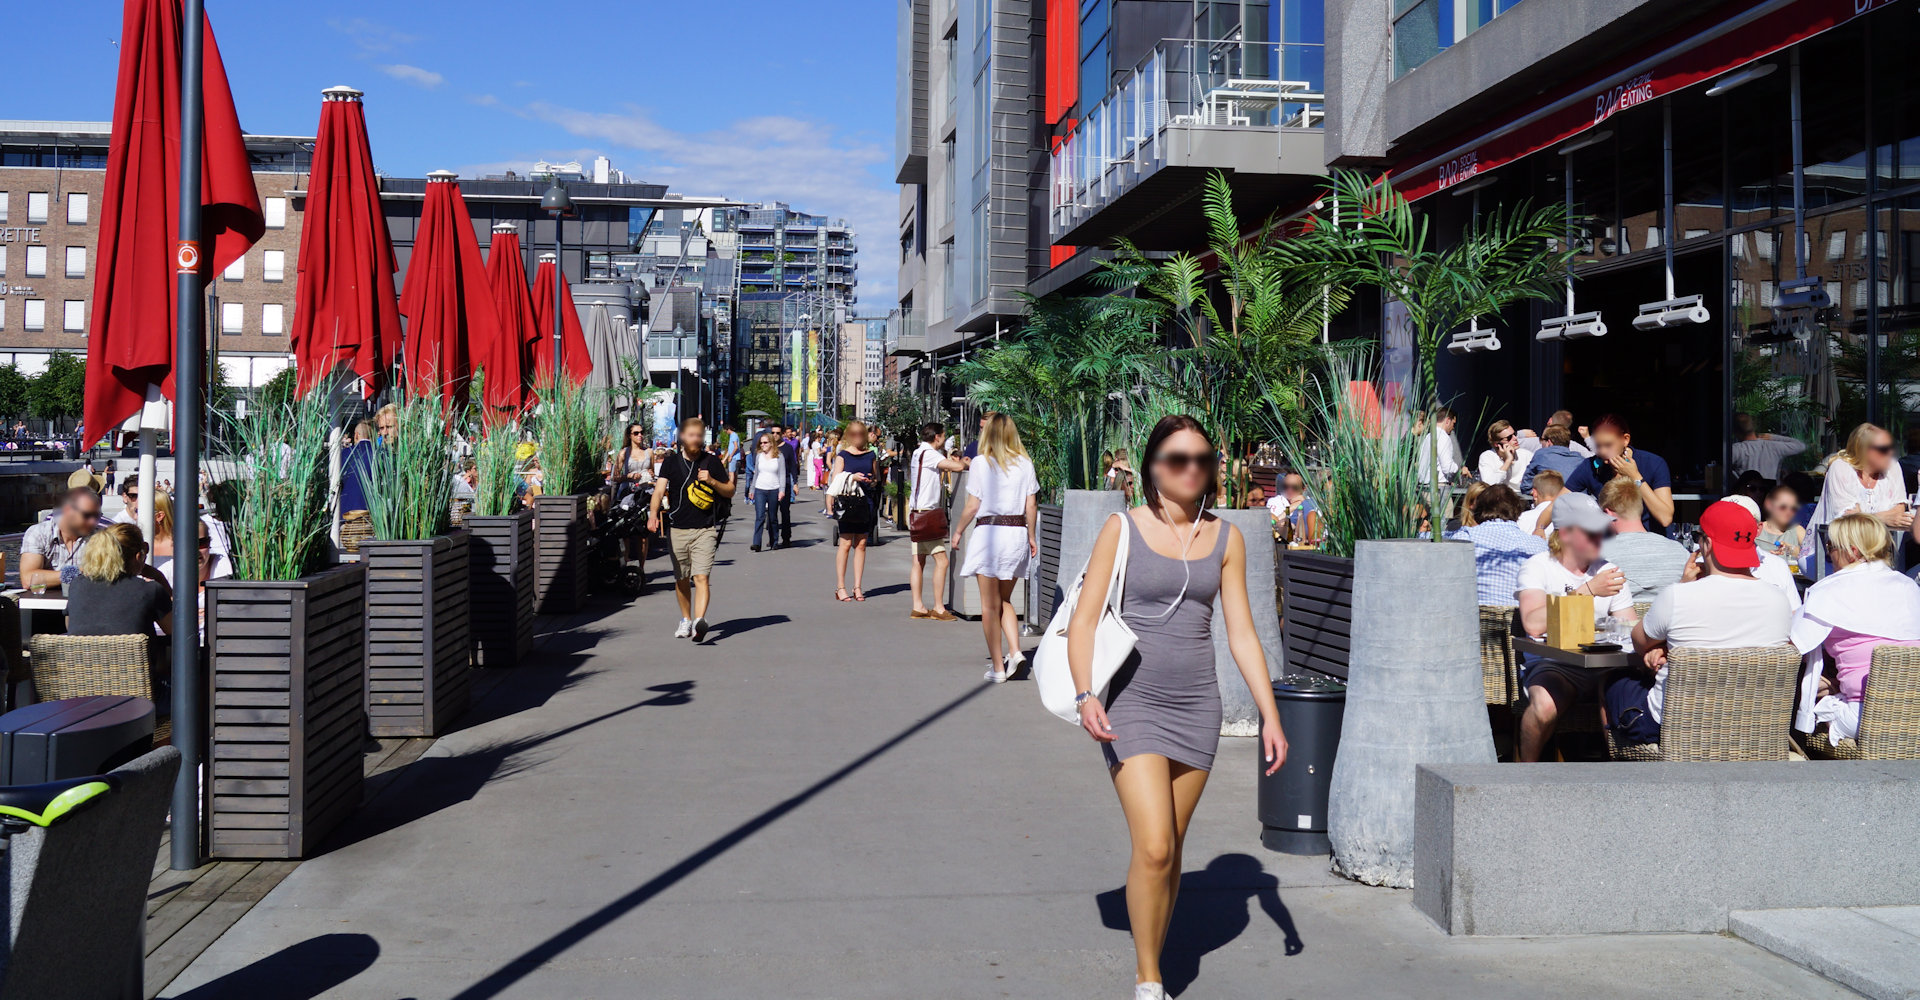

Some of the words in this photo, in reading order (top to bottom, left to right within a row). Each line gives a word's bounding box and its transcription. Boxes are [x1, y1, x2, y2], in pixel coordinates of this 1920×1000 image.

[1621, 84, 1653, 108] EATING
[1460, 151, 1478, 167] SOCIAL
[1439, 160, 1458, 190] BAR
[1460, 162, 1478, 181] EATING
[1385, 313, 1413, 350] BAR
